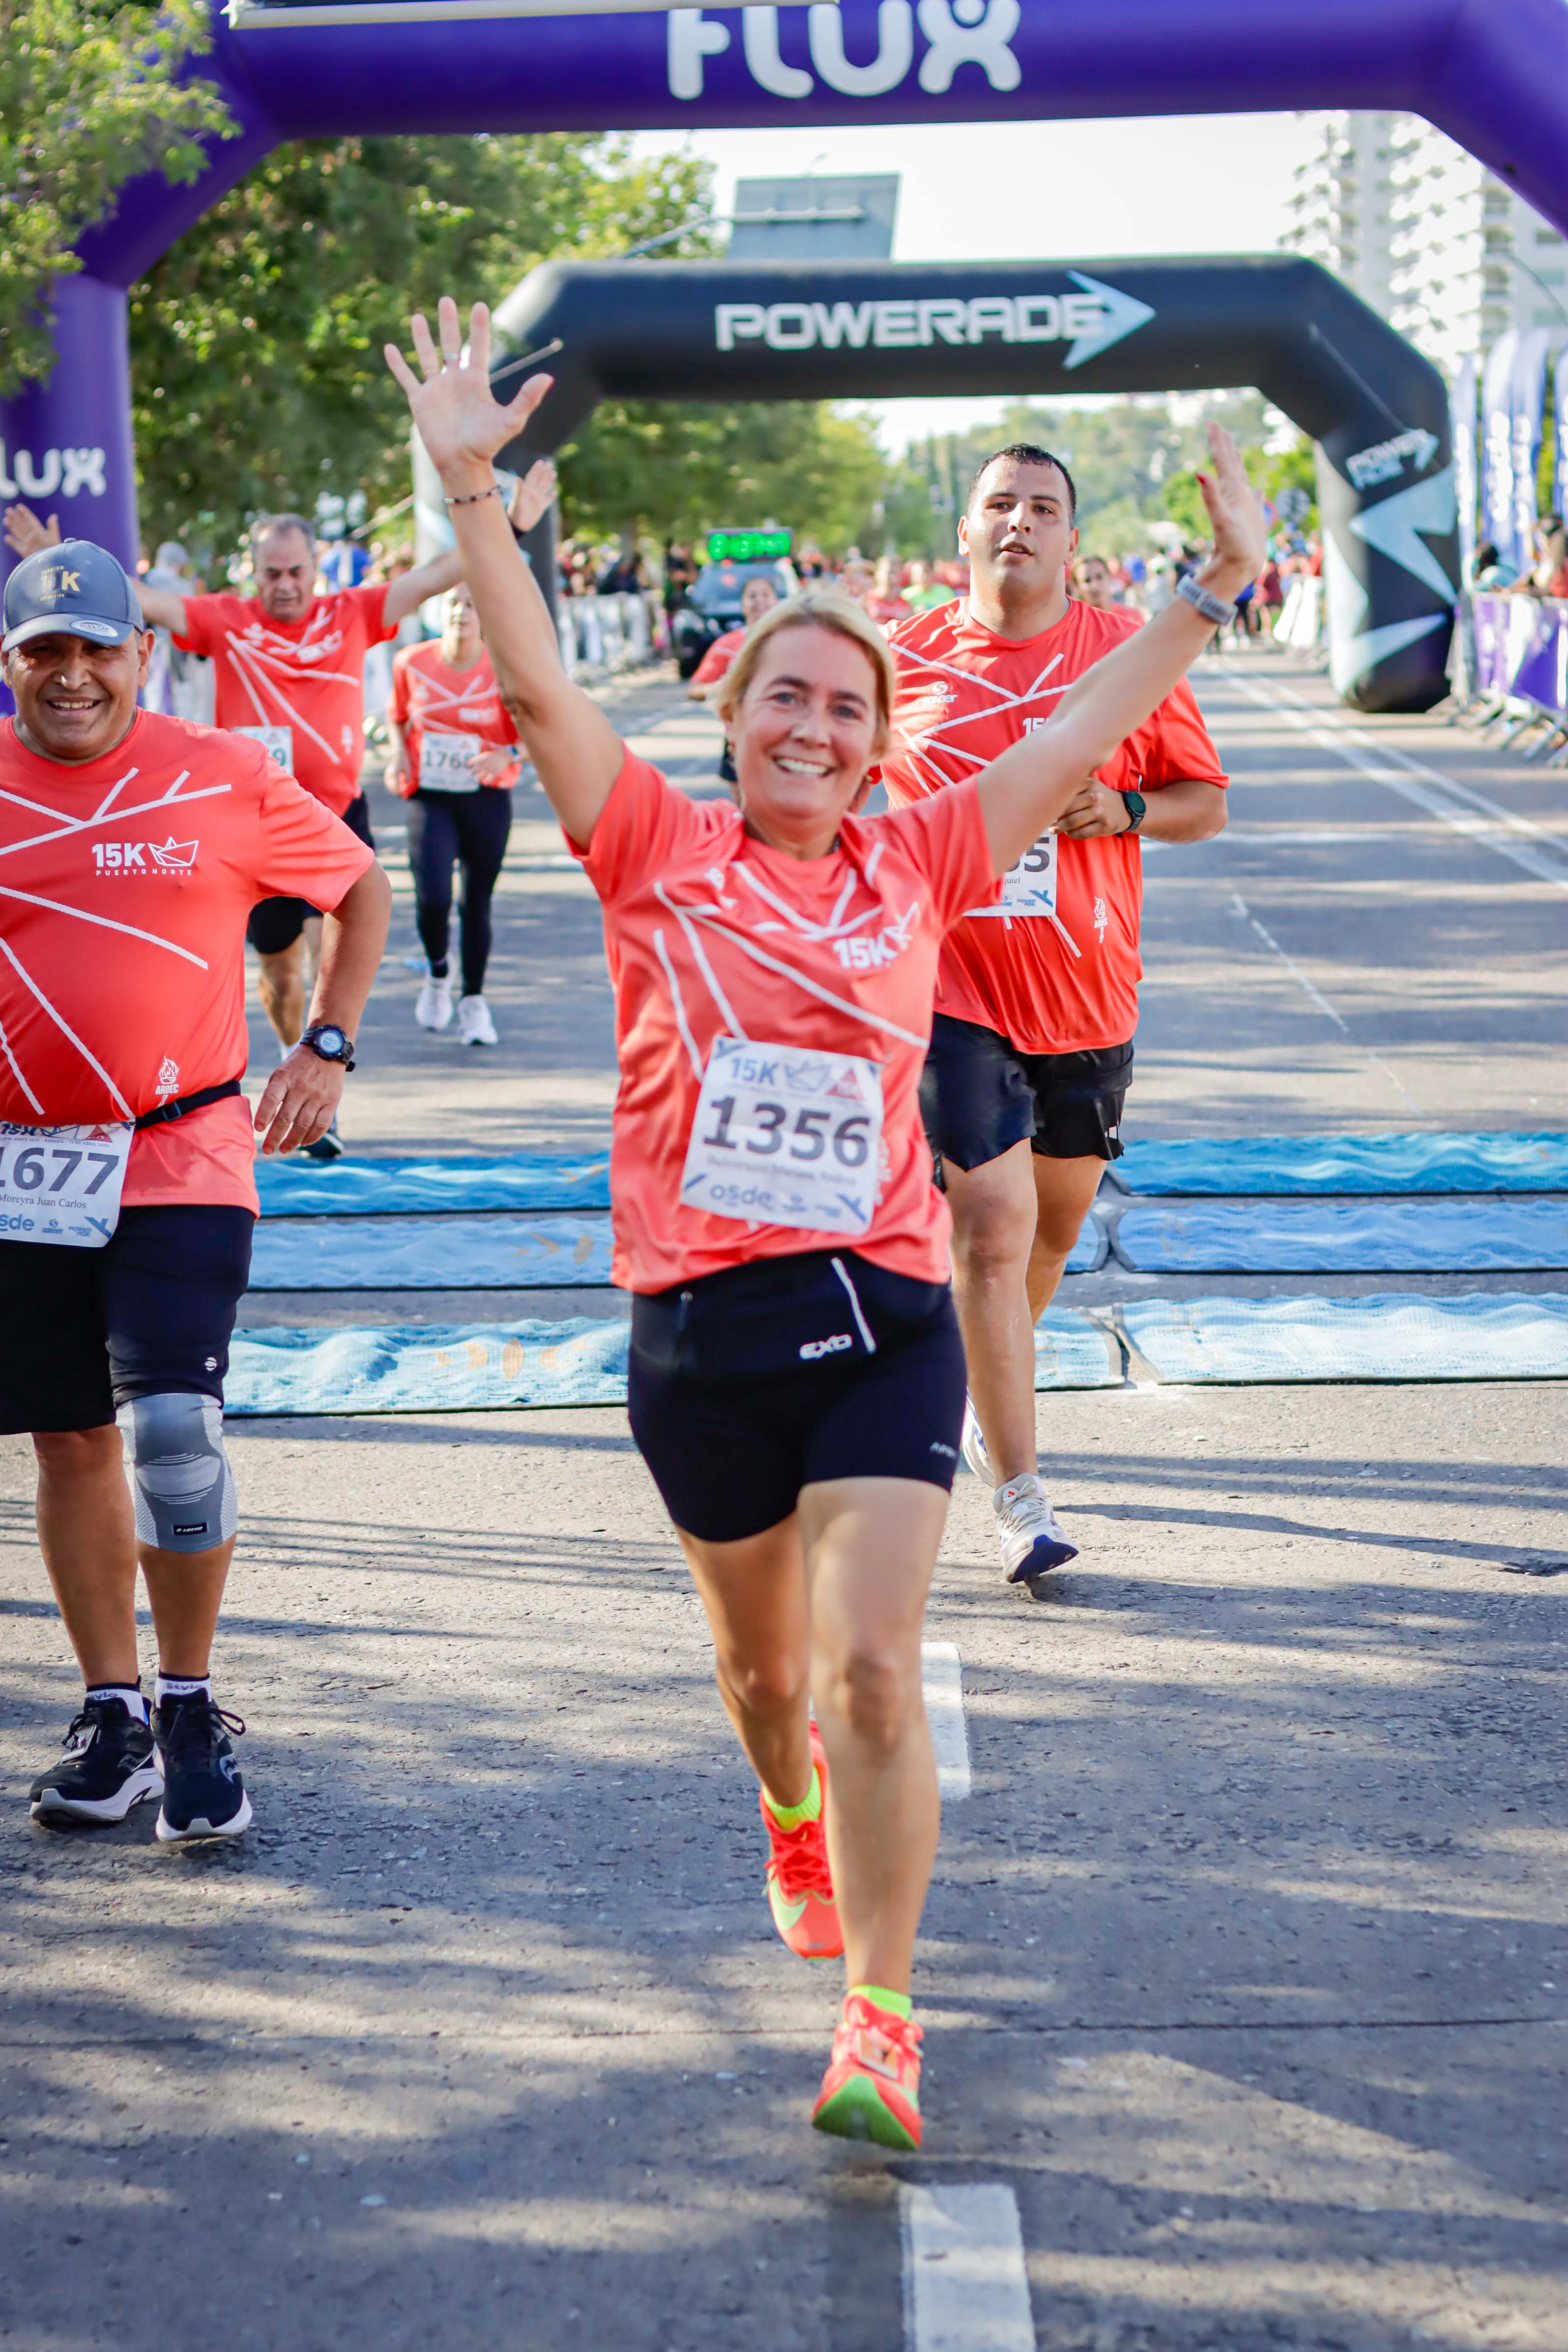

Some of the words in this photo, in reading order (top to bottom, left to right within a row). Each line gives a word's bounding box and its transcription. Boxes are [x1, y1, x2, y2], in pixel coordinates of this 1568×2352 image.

[667, 0, 1022, 100] FLUX
[715, 294, 1105, 351] POWERADE
[1023, 717, 1050, 736] 15
[92, 842, 146, 867] 15K
[1004, 837, 1050, 872] 5
[833, 933, 898, 969] 15K
[731, 1057, 779, 1085] 15K
[703, 1095, 870, 1167] 1356
[0, 1194, 34, 1205] Moreyra
[36, 1197, 56, 1206] Juan
[59, 1198, 87, 1209] Carlos
[710, 1184, 773, 1211] osde
